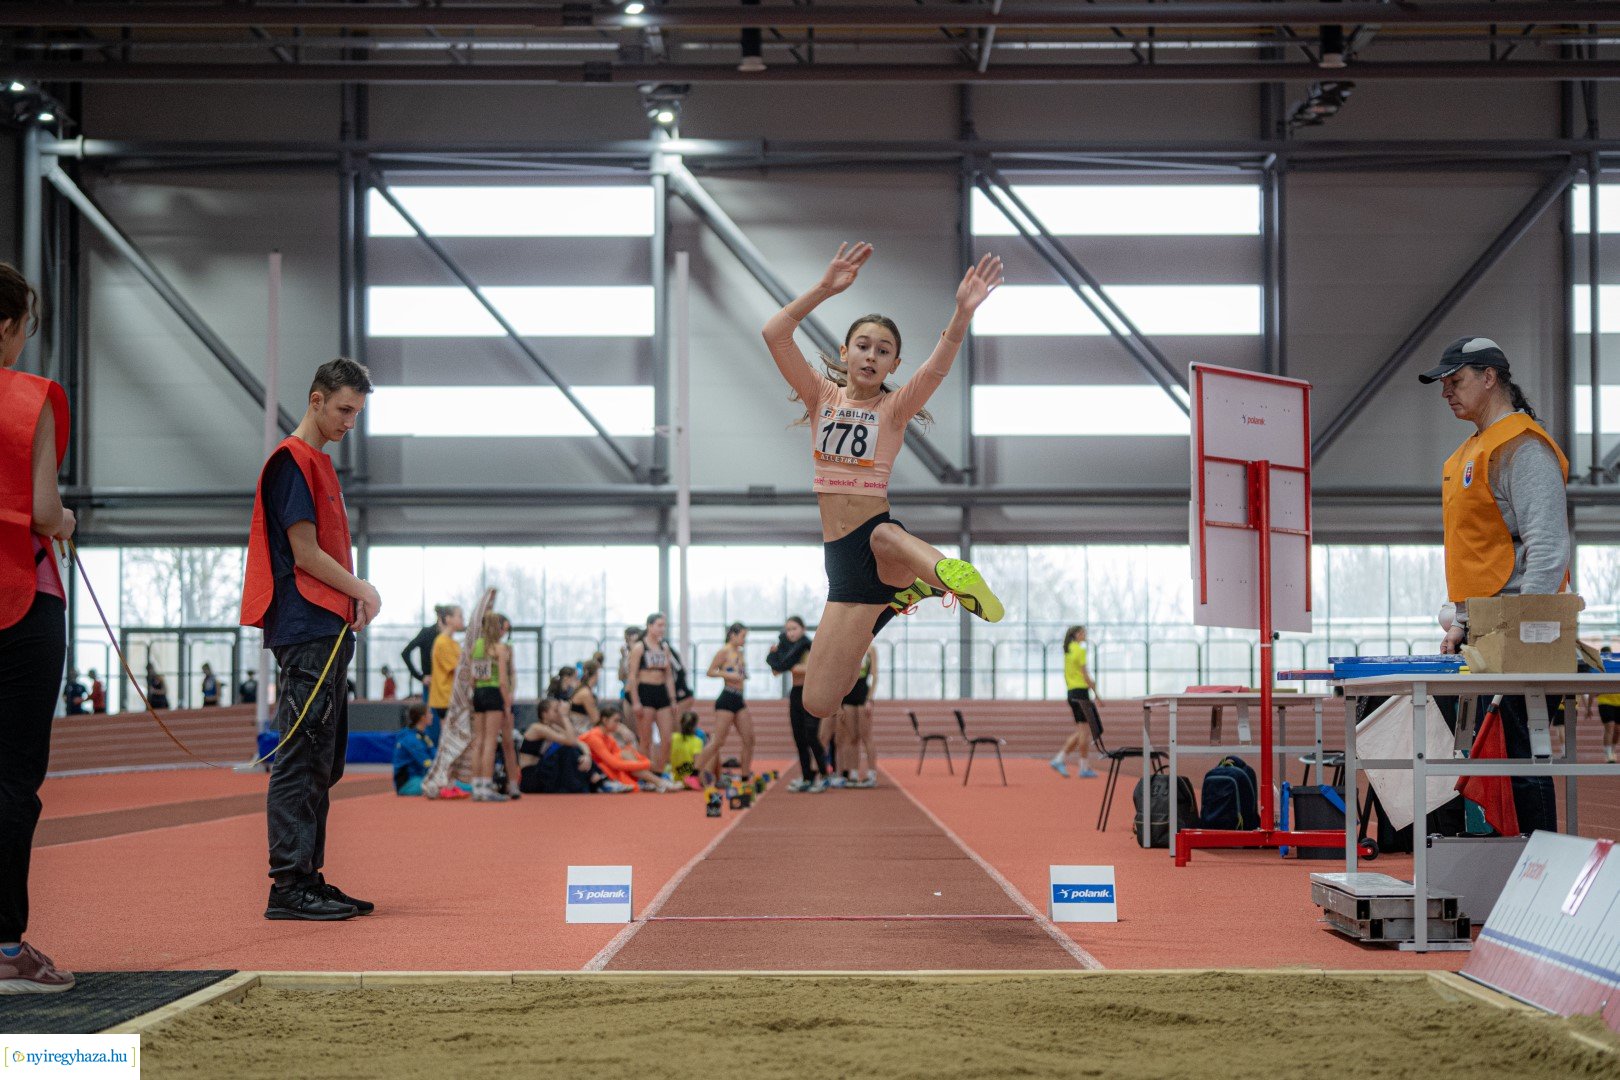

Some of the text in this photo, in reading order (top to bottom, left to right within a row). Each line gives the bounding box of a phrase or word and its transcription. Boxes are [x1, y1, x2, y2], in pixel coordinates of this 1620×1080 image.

[821, 421, 869, 458] 178
[820, 453, 859, 465] ATLETIKA
[586, 889, 625, 900] polanik
[1071, 888, 1109, 899] polanik
